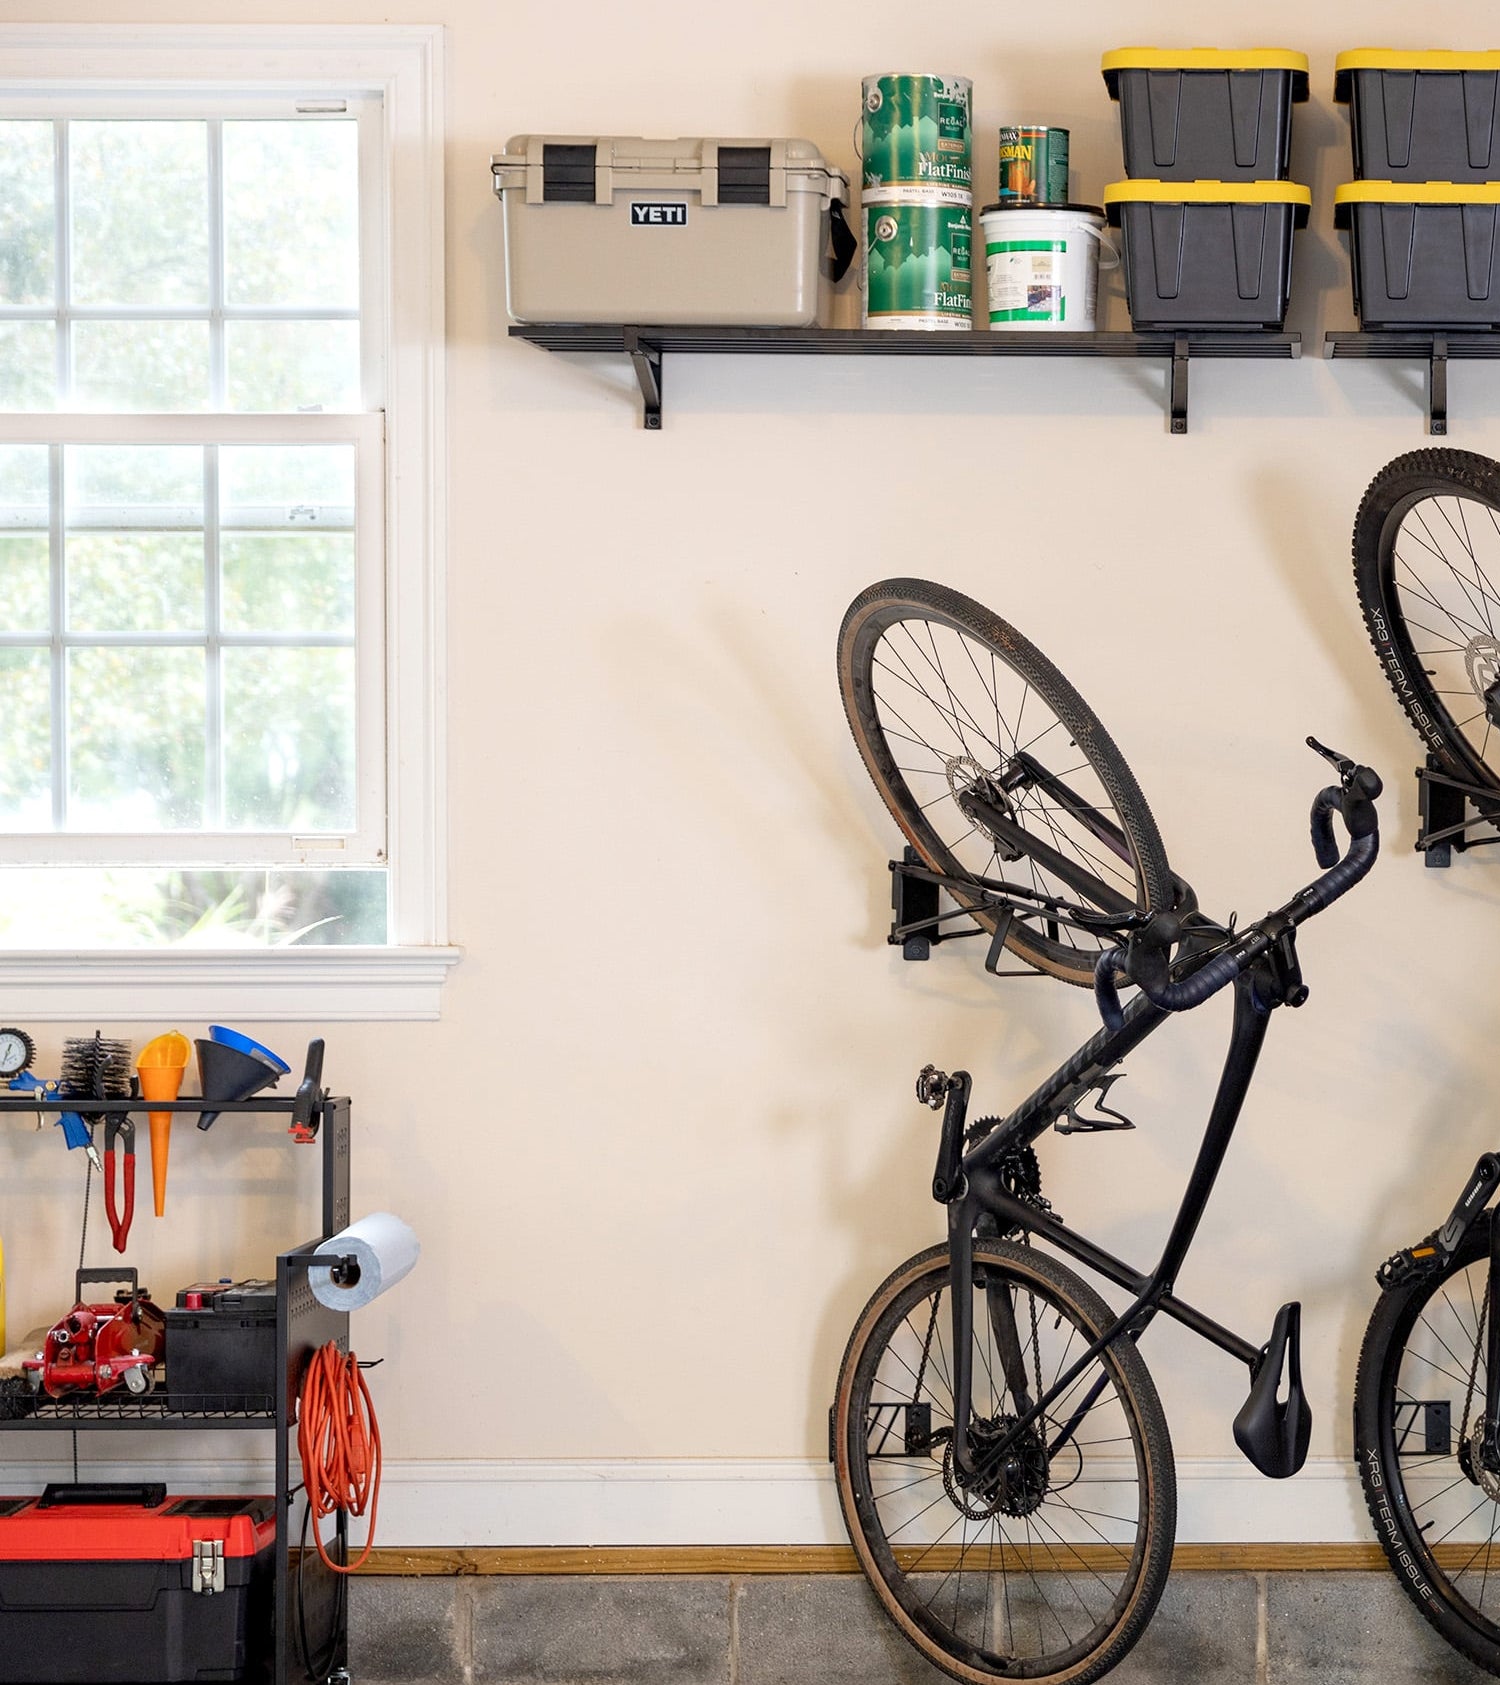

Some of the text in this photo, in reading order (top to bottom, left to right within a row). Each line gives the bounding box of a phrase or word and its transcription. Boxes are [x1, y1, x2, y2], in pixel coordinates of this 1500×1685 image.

[634, 206, 683, 222] YETI
[1370, 607, 1444, 749] XR3 TEAM ISSUE
[1367, 1448, 1433, 1600] XR3 TEAM ISSUE
